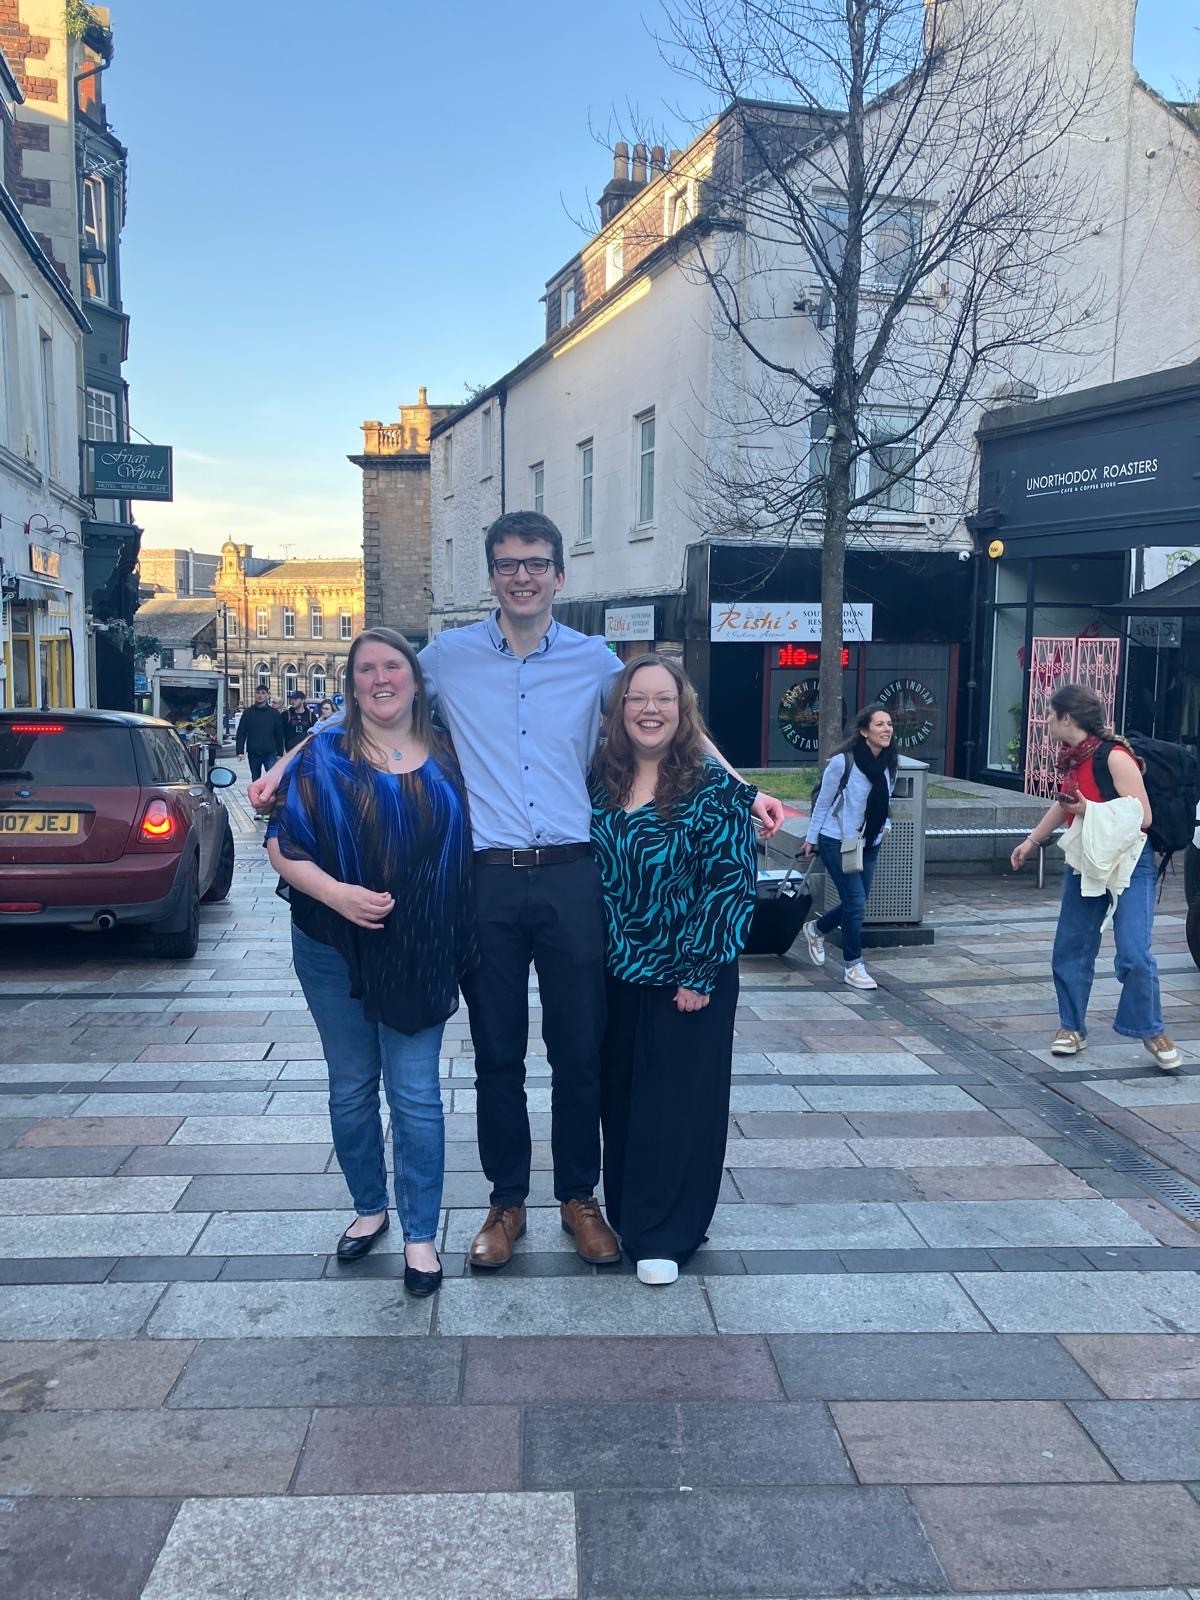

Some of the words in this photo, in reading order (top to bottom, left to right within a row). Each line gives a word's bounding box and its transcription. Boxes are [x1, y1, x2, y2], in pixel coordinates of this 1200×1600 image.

[101, 448, 150, 465] Friars
[117, 462, 165, 483] Wynd
[1026, 467, 1098, 491] UNORTHODOX
[1103, 458, 1158, 479] ROASTERS
[716, 608, 798, 632] Rishi's
[905, 679, 935, 705] INDIAN
[35, 815, 71, 832] JEJ
